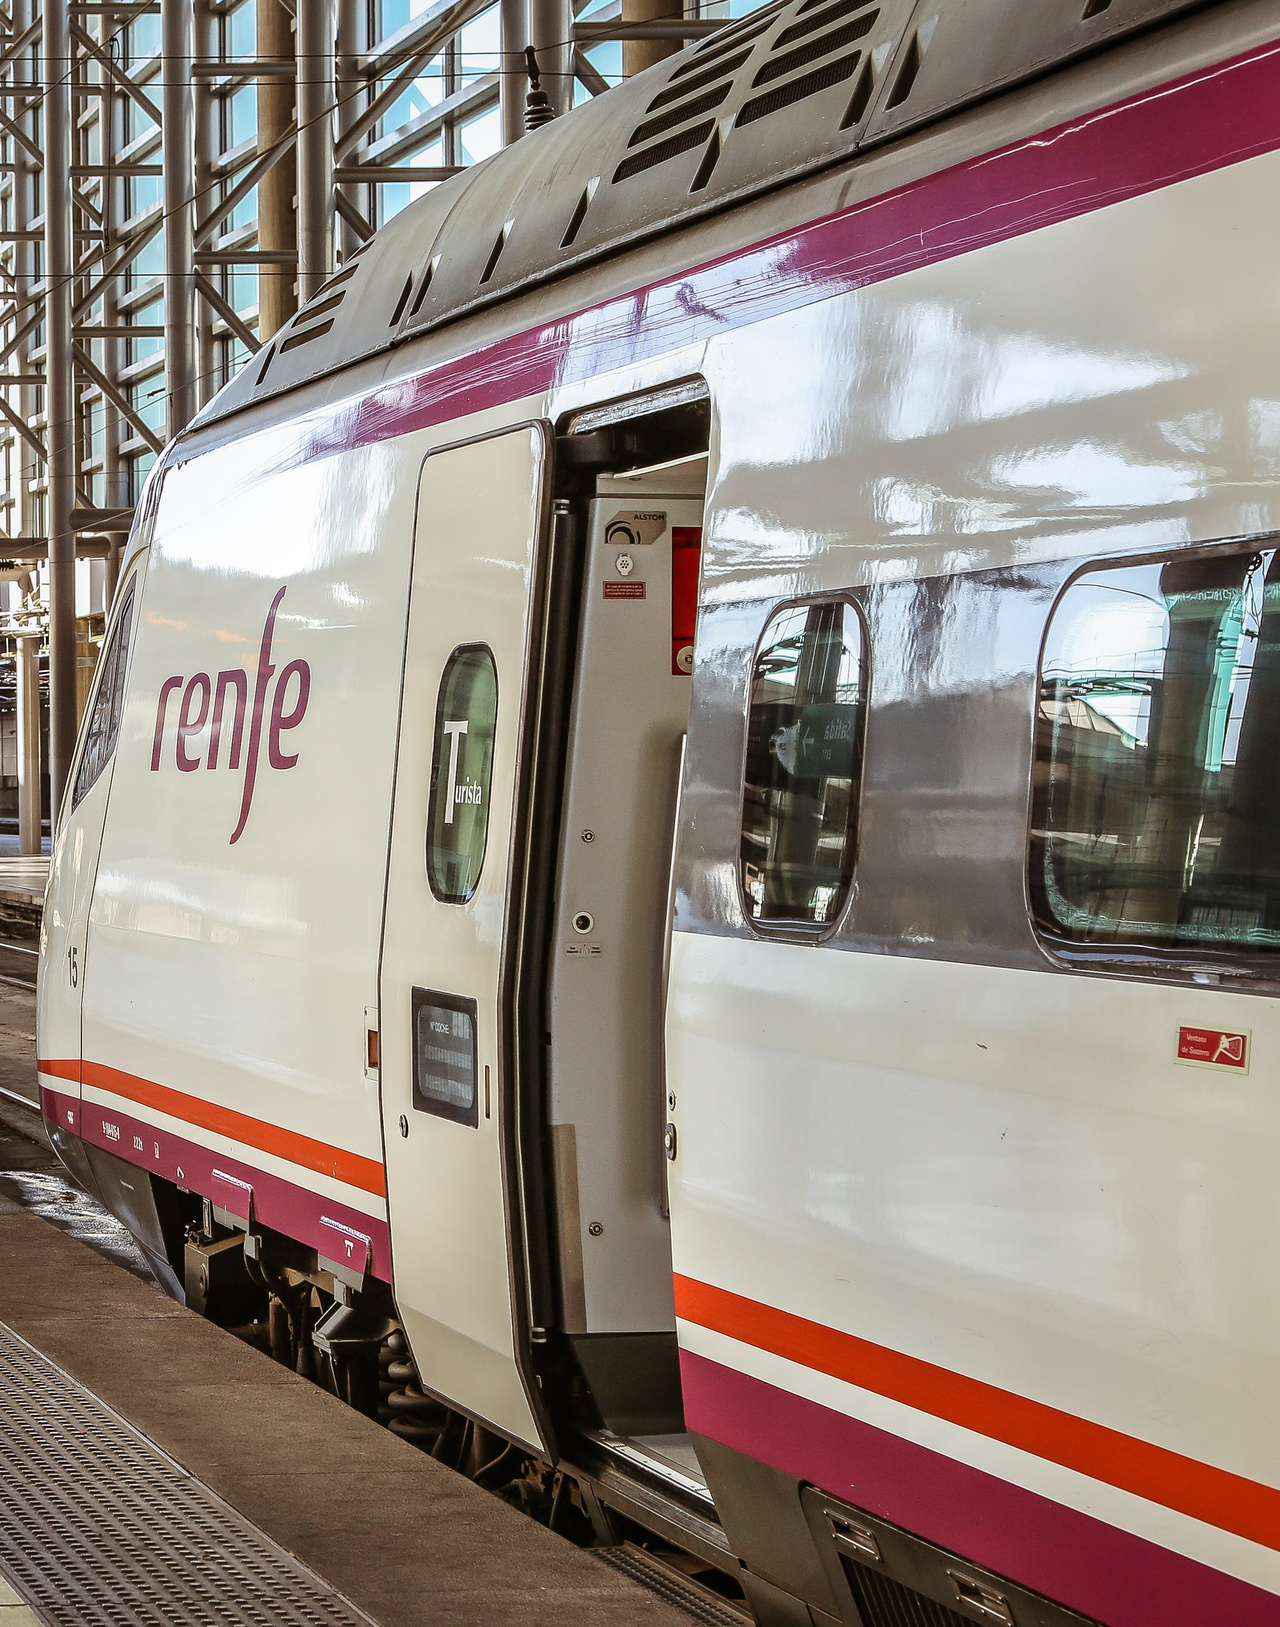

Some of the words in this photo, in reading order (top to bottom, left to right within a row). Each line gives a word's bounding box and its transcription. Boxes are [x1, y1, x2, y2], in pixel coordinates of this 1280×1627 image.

[150, 584, 311, 845] renfe
[443, 720, 482, 824] Turista
[68, 945, 78, 988] 15
[1181, 1046, 1189, 1054] de
[1189, 1046, 1210, 1057] Socorro
[1186, 1033, 1207, 1043] Ventana
